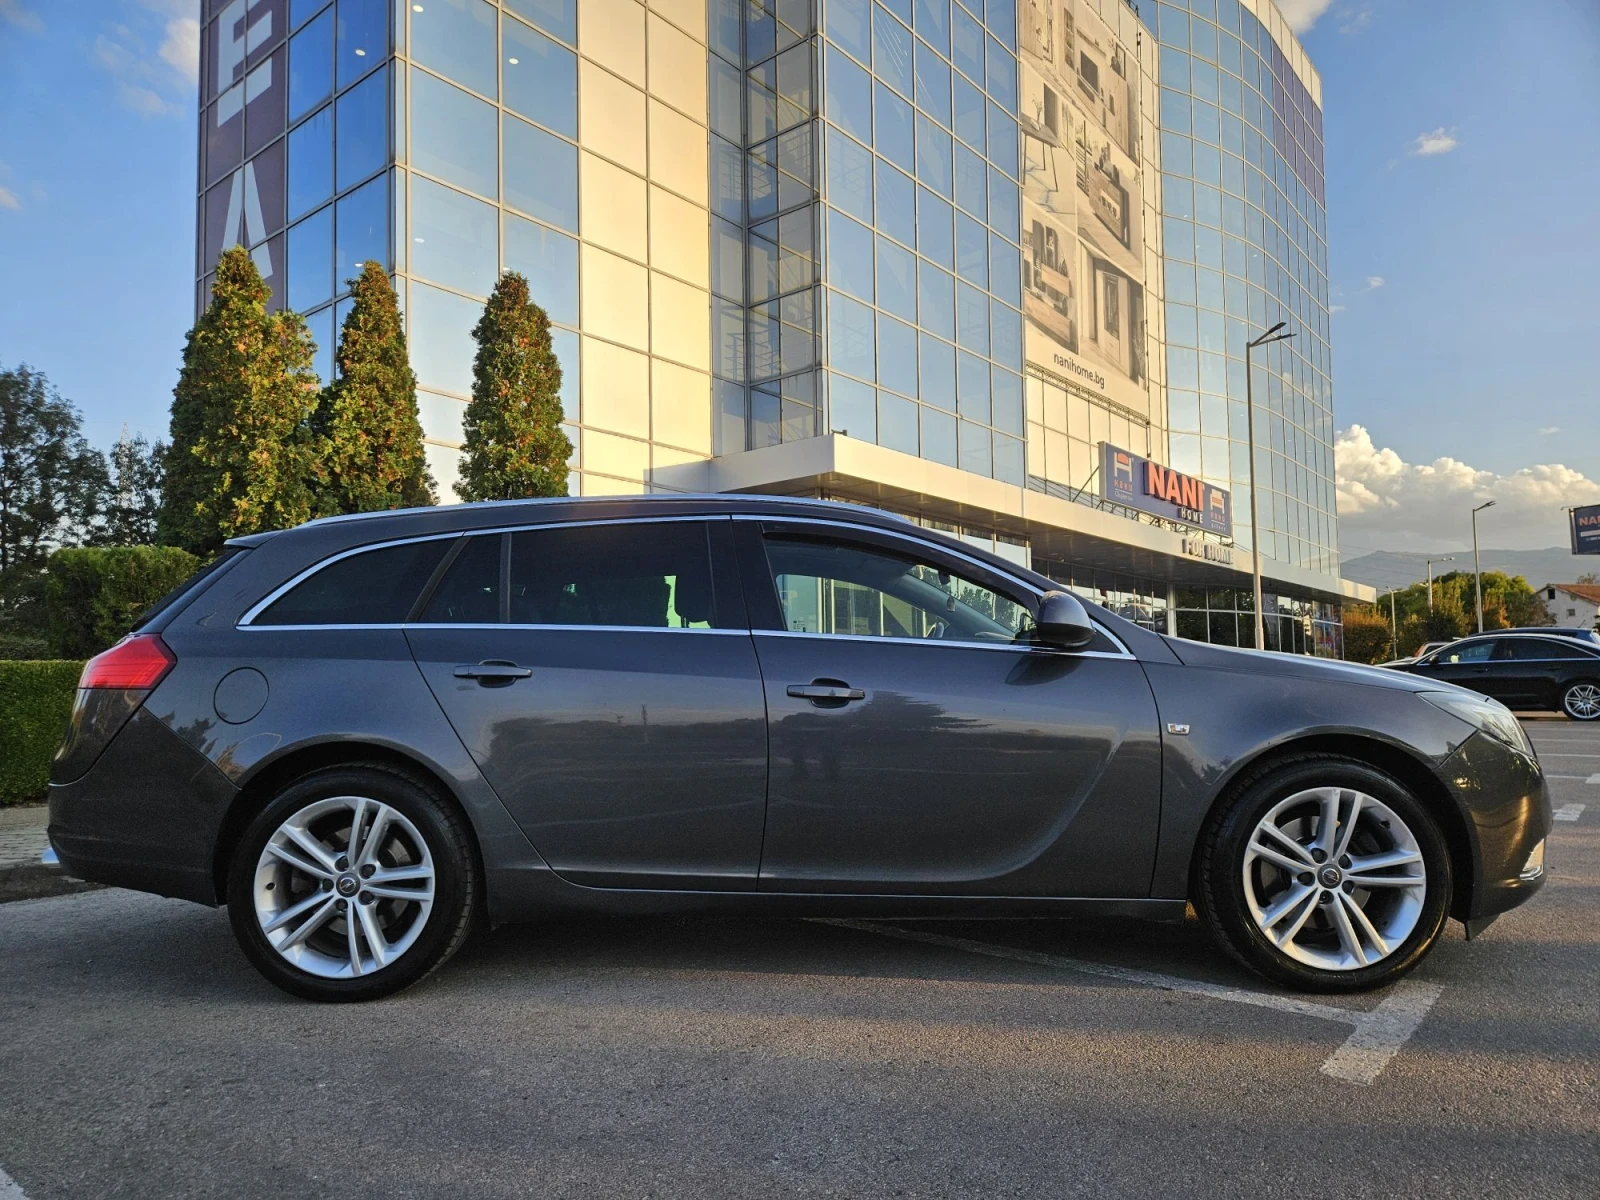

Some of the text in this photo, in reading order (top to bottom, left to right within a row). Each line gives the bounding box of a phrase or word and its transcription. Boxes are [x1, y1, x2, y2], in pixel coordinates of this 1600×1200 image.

[1053, 352, 1105, 389] nanihome.bg
[1148, 461, 1203, 512] NANI
[1181, 507, 1203, 524] HOME
